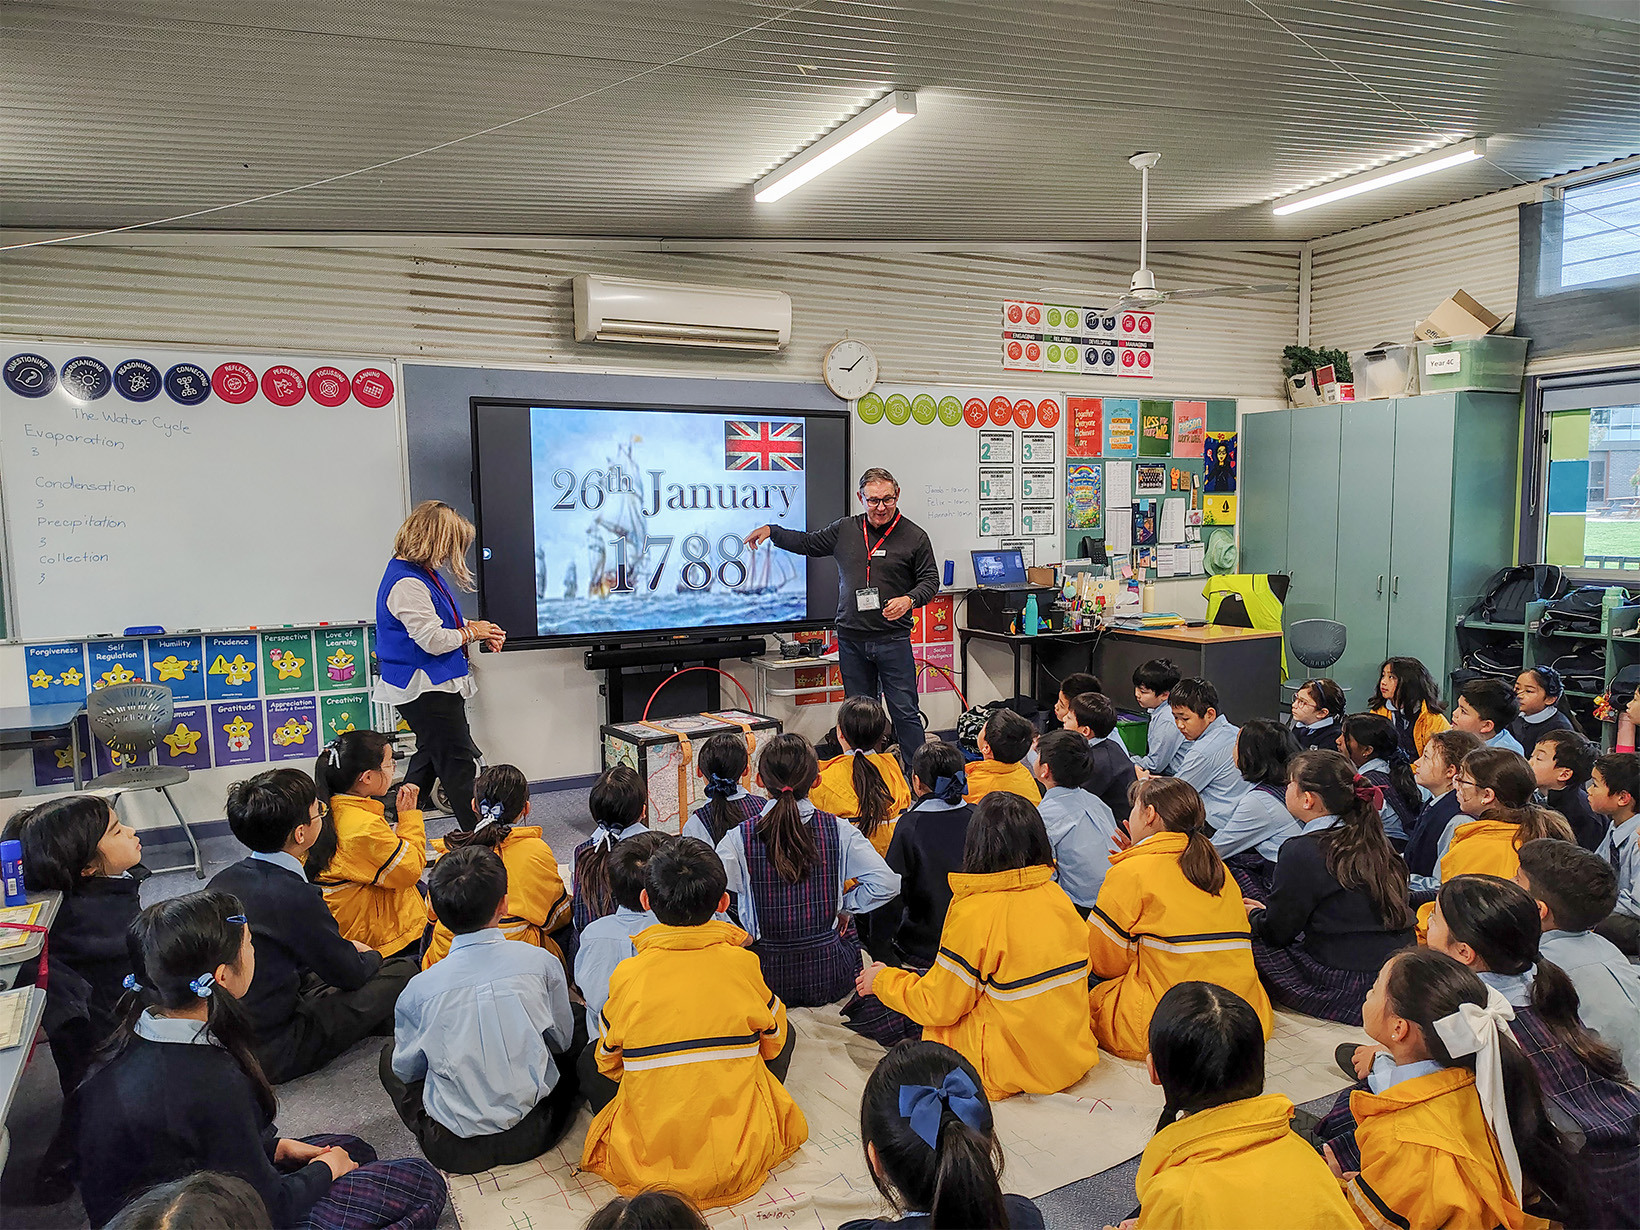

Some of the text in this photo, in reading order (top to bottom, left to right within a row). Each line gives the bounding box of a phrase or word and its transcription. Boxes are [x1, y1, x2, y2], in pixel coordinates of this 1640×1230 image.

[8, 356, 48, 372] QUESTIONING
[118, 362, 151, 376] REASONING
[176, 366, 208, 387] CONNECTING
[224, 365, 254, 382] REFLECTING
[272, 368, 304, 389] PERSEVERING
[316, 370, 346, 383] FOCUSSING
[356, 372, 380, 384] PLANNING
[72, 408, 192, 438] The Water Cycle
[24, 424, 124, 450] Evaporation
[32, 447, 40, 457] 3
[982, 443, 991, 460] 2
[1024, 444, 1032, 460] 3
[35, 476, 136, 493] Condensation
[551, 466, 799, 518] 26th January
[981, 480, 991, 496] 4
[1024, 480, 1032, 496] 5
[36, 499, 44, 508] 3
[37, 514, 126, 534] Precipitation
[982, 516, 990, 533] 6
[1024, 516, 1032, 532] 9
[38, 537, 47, 548] 3
[608, 532, 748, 594] 1788
[38, 573, 46, 584] 3
[159, 640, 191, 648] Humility
[264, 633, 308, 642] Perspective
[326, 639, 358, 648] Learning
[30, 646, 78, 658] Forgiveness
[108, 644, 124, 652] Self
[96, 652, 138, 662] Regulation
[270, 700, 312, 709] Appreciation
[326, 696, 364, 705] Creativity
[218, 704, 256, 713] Gratitude
